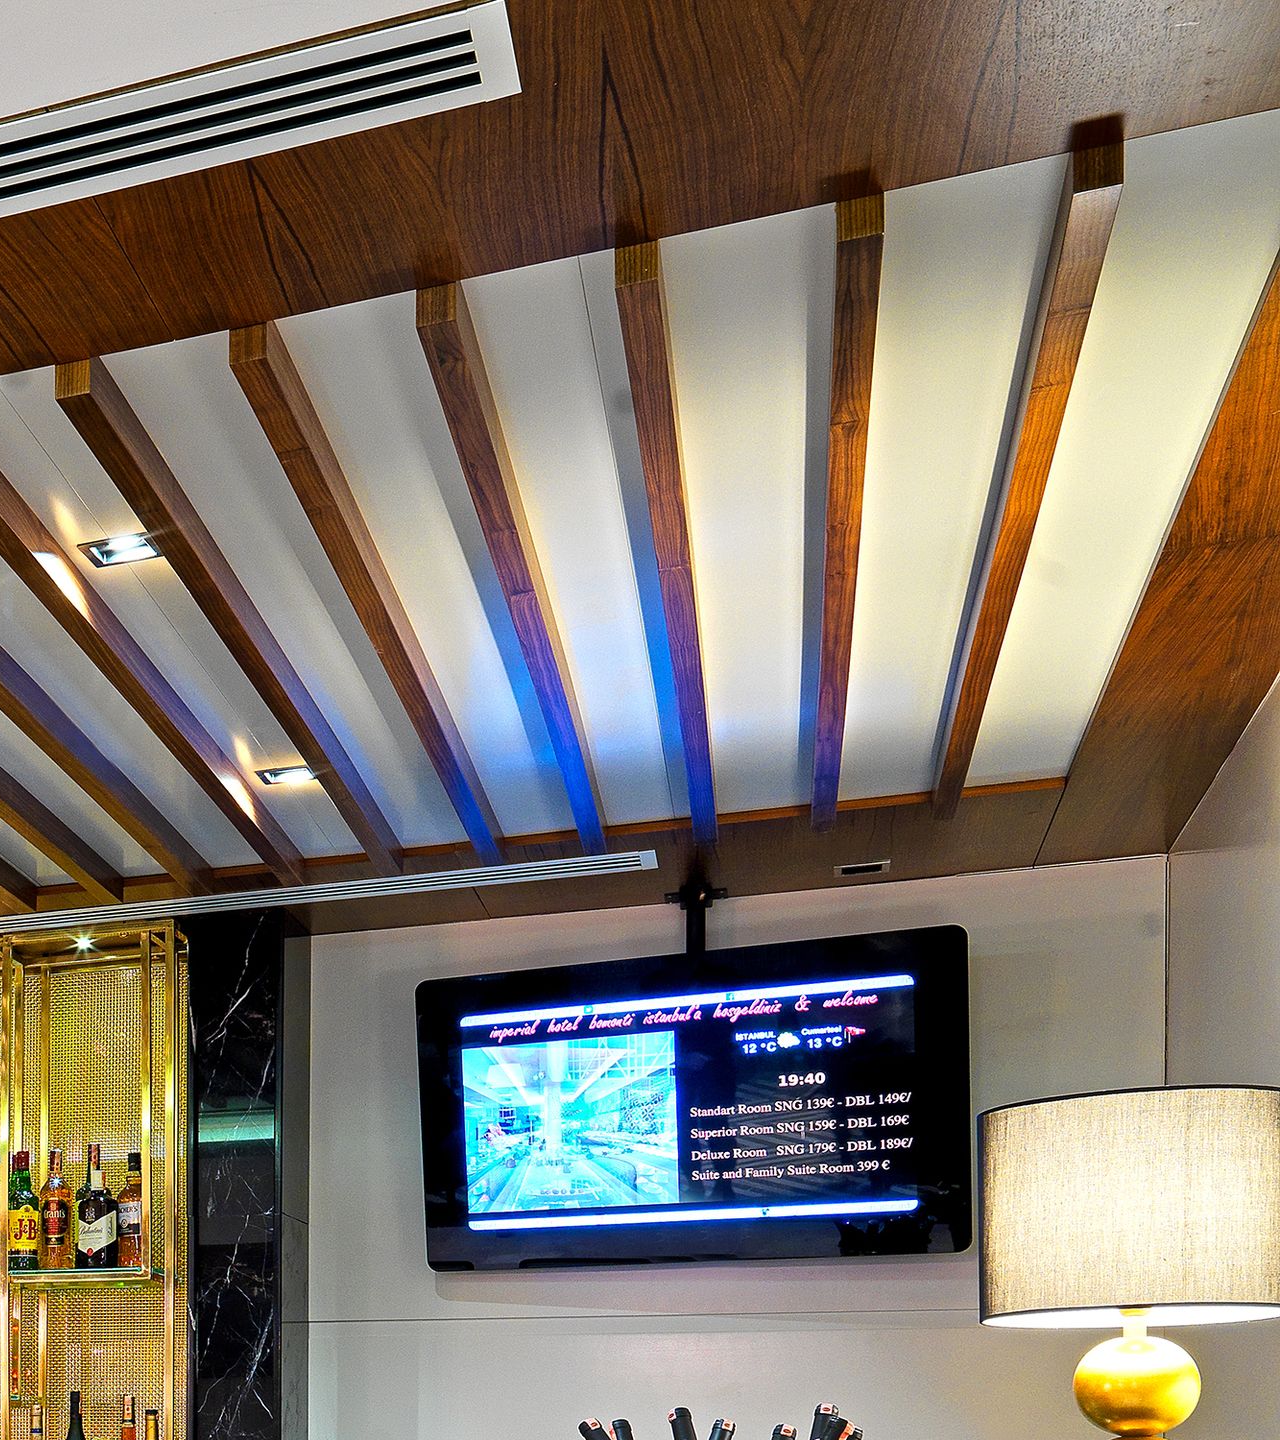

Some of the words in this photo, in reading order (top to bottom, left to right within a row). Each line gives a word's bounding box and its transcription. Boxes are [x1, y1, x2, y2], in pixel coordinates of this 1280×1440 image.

[490, 1019, 541, 1043] imperial
[547, 1015, 583, 1034] hotel
[589, 1013, 636, 1030] bomonti
[713, 996, 782, 1022] hosgeldiniz
[795, 994, 812, 1011] &
[823, 990, 879, 1009] welcome
[742, 1043, 758, 1054] 12
[807, 1038, 822, 1049] 13
[778, 1071, 826, 1087] 19:40
[690, 1106, 736, 1117] Standart
[738, 1104, 772, 1114] Room
[774, 1099, 803, 1112] SNG
[807, 1097, 835, 1109] 139€
[845, 1095, 875, 1107] DBL
[690, 1127, 738, 1140] Superior
[740, 1125, 774, 1136] Room
[777, 1121, 805, 1133] SNG
[809, 1119, 837, 1131] 159€
[847, 1117, 877, 1129] DBL
[881, 1115, 910, 1127] 169€
[691, 1150, 731, 1161] Deluxe
[733, 1148, 767, 1158] Room
[776, 1144, 805, 1156] SNG
[809, 1142, 837, 1154] 179€
[847, 1140, 877, 1152] DBL
[692, 1169, 720, 1181] Suite
[722, 1168, 742, 1179] and
[745, 1166, 785, 1178] Family
[787, 1164, 817, 1176] Suite
[819, 1163, 854, 1174] Room
[857, 1160, 879, 1172] 399
[881, 1159, 891, 1171] €
[44, 1208, 66, 1219] Grant's
[14, 1218, 39, 1241] J&B
